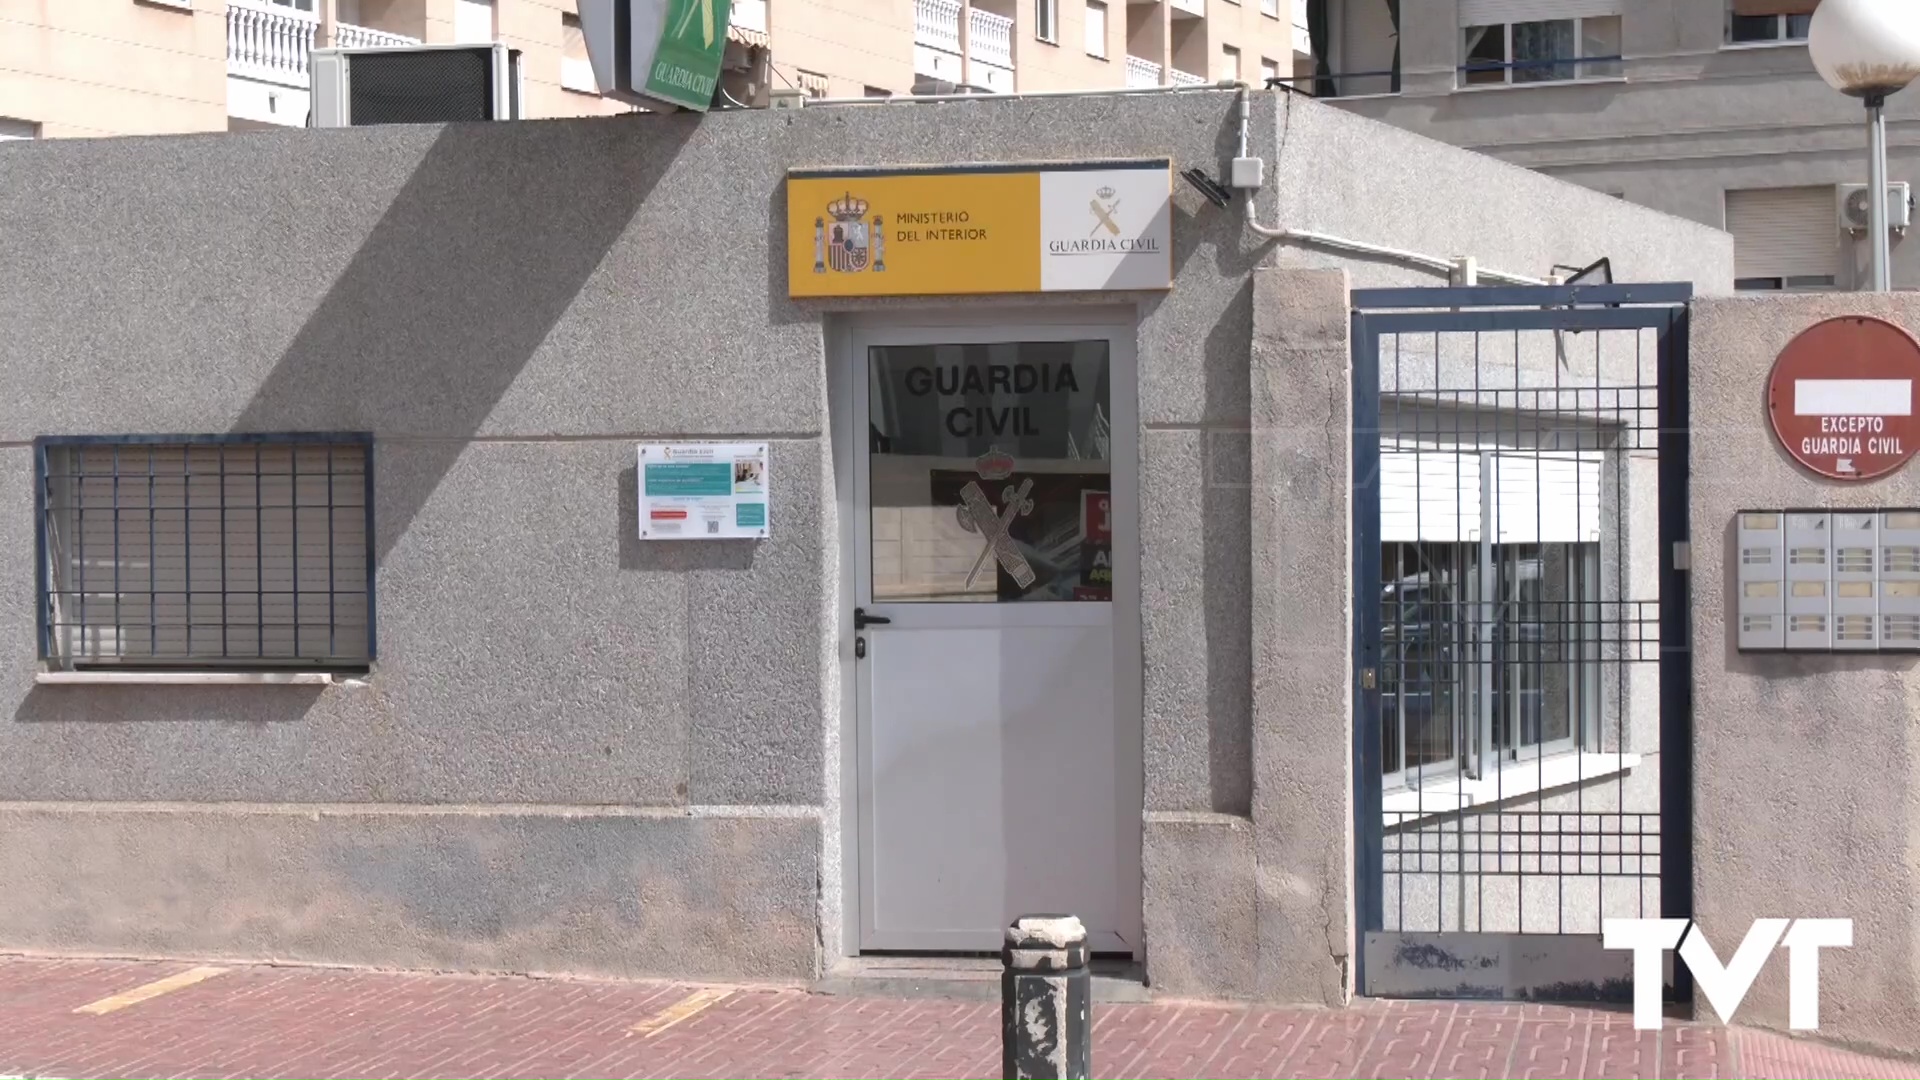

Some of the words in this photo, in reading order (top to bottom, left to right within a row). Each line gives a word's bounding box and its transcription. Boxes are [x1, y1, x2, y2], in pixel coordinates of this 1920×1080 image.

[655, 62, 693, 89] GUARDIA
[692, 75, 714, 97] CIVIL
[896, 211, 970, 225] MINISTERIO
[896, 229, 921, 242] DEL
[925, 228, 987, 241] INTERIOR
[1049, 239, 1117, 253] GUARDIA
[1119, 238, 1160, 251] CIVIL
[904, 363, 1080, 397] GUARDIA
[945, 406, 1040, 438] CIVIL
[1821, 417, 1884, 433] EXCEPTO
[1801, 437, 1862, 455] GUARDIA
[1868, 437, 1903, 455] CIVIL
